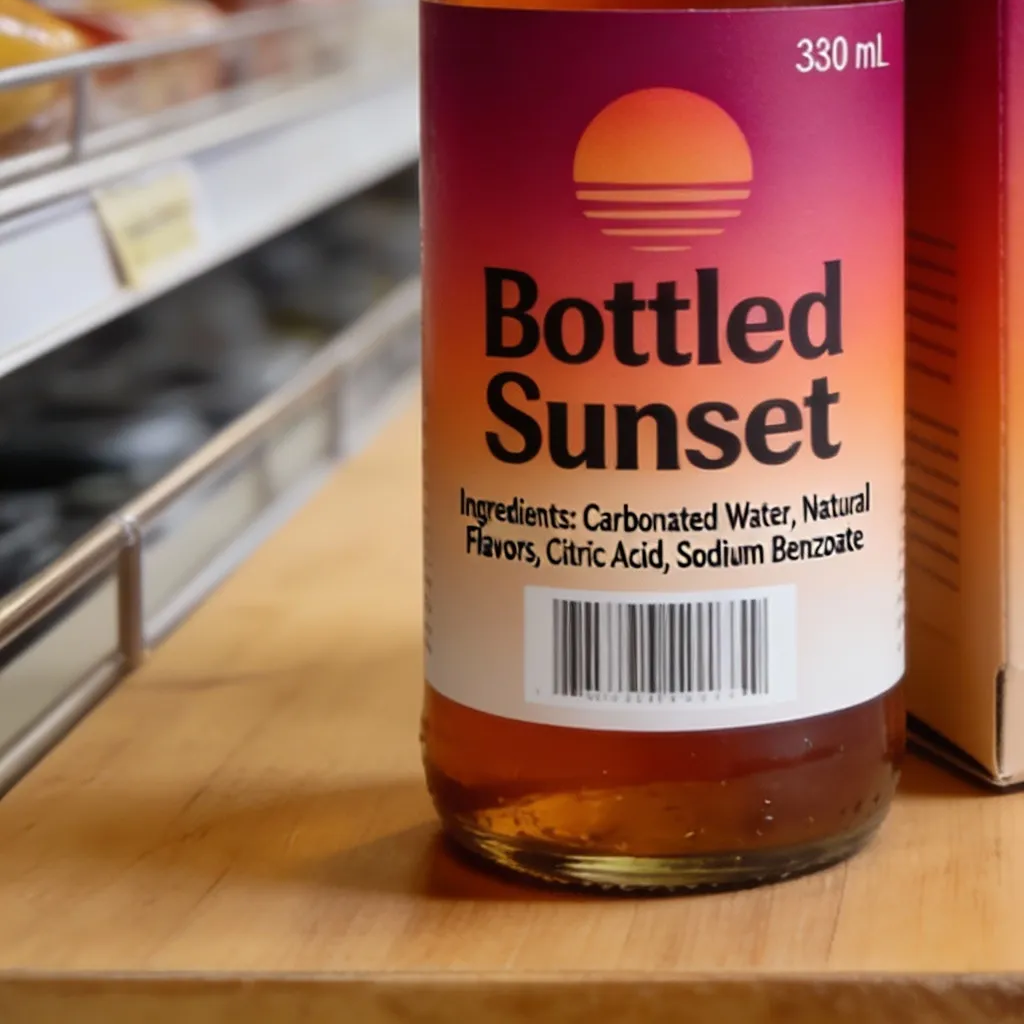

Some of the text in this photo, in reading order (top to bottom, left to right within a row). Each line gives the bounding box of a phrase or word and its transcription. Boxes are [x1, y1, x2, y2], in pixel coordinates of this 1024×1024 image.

[795, 31, 891, 73] 330 mL
[483, 259, 845, 368] Bottled
[485, 370, 842, 472] Sunset
[459, 481, 871, 533] Ingredients: Carbonated Water, Natural
[466, 525, 865, 574] Flavors, Citric Acid, Sodium Benzoate
